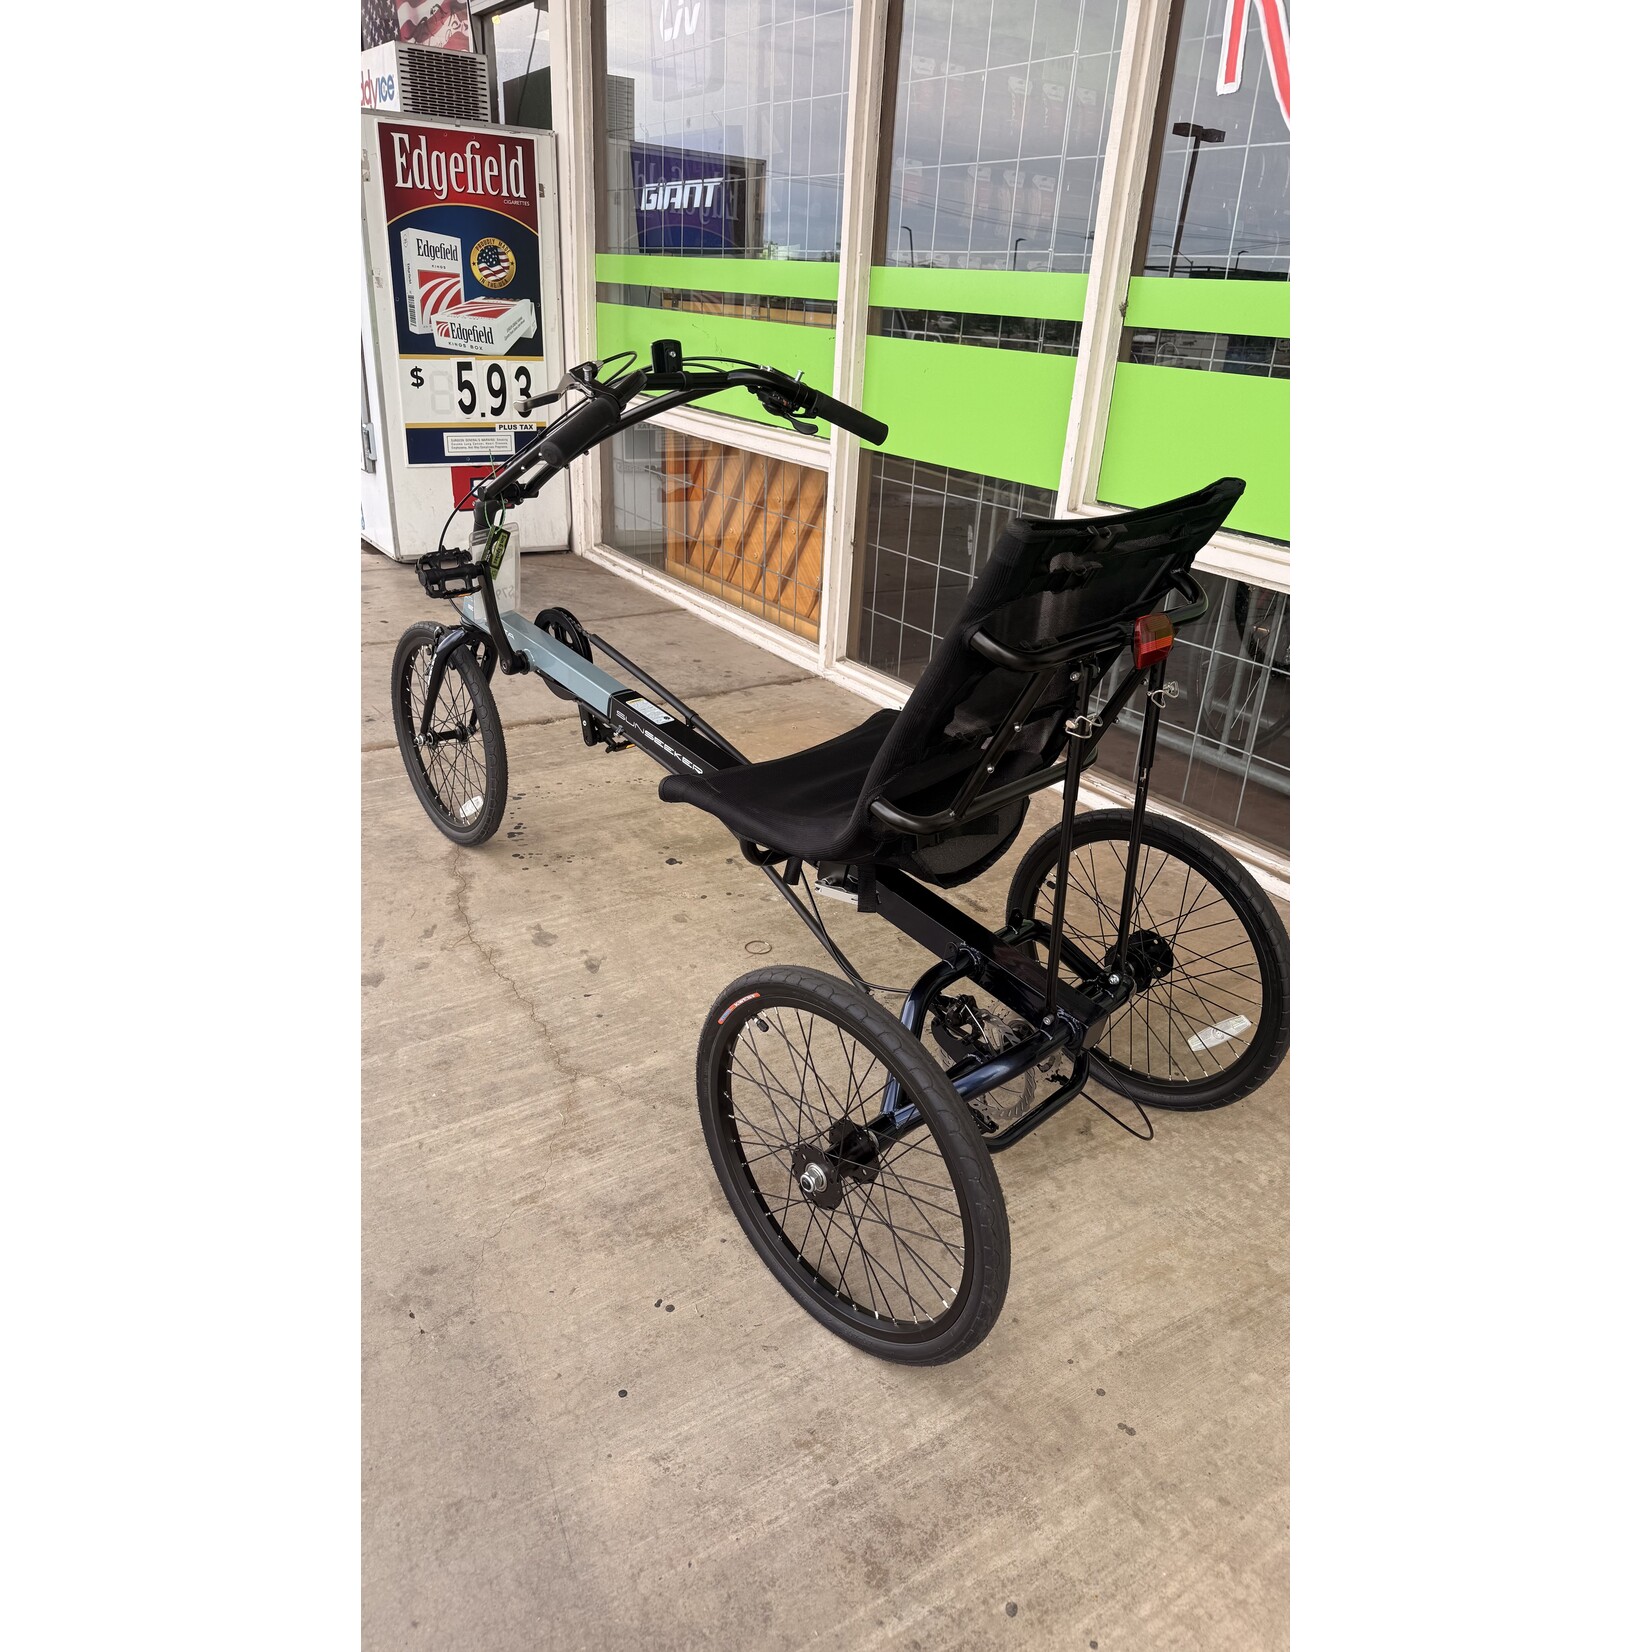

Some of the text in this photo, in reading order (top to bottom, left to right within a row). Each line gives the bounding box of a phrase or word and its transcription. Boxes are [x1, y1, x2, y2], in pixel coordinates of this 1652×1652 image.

[390, 132, 527, 200] Edgefield
[640, 177, 724, 211] GIANT
[416, 238, 459, 262] Edgefield
[449, 321, 495, 345] Edgefield
[616, 710, 703, 775] SUNSEEKER
